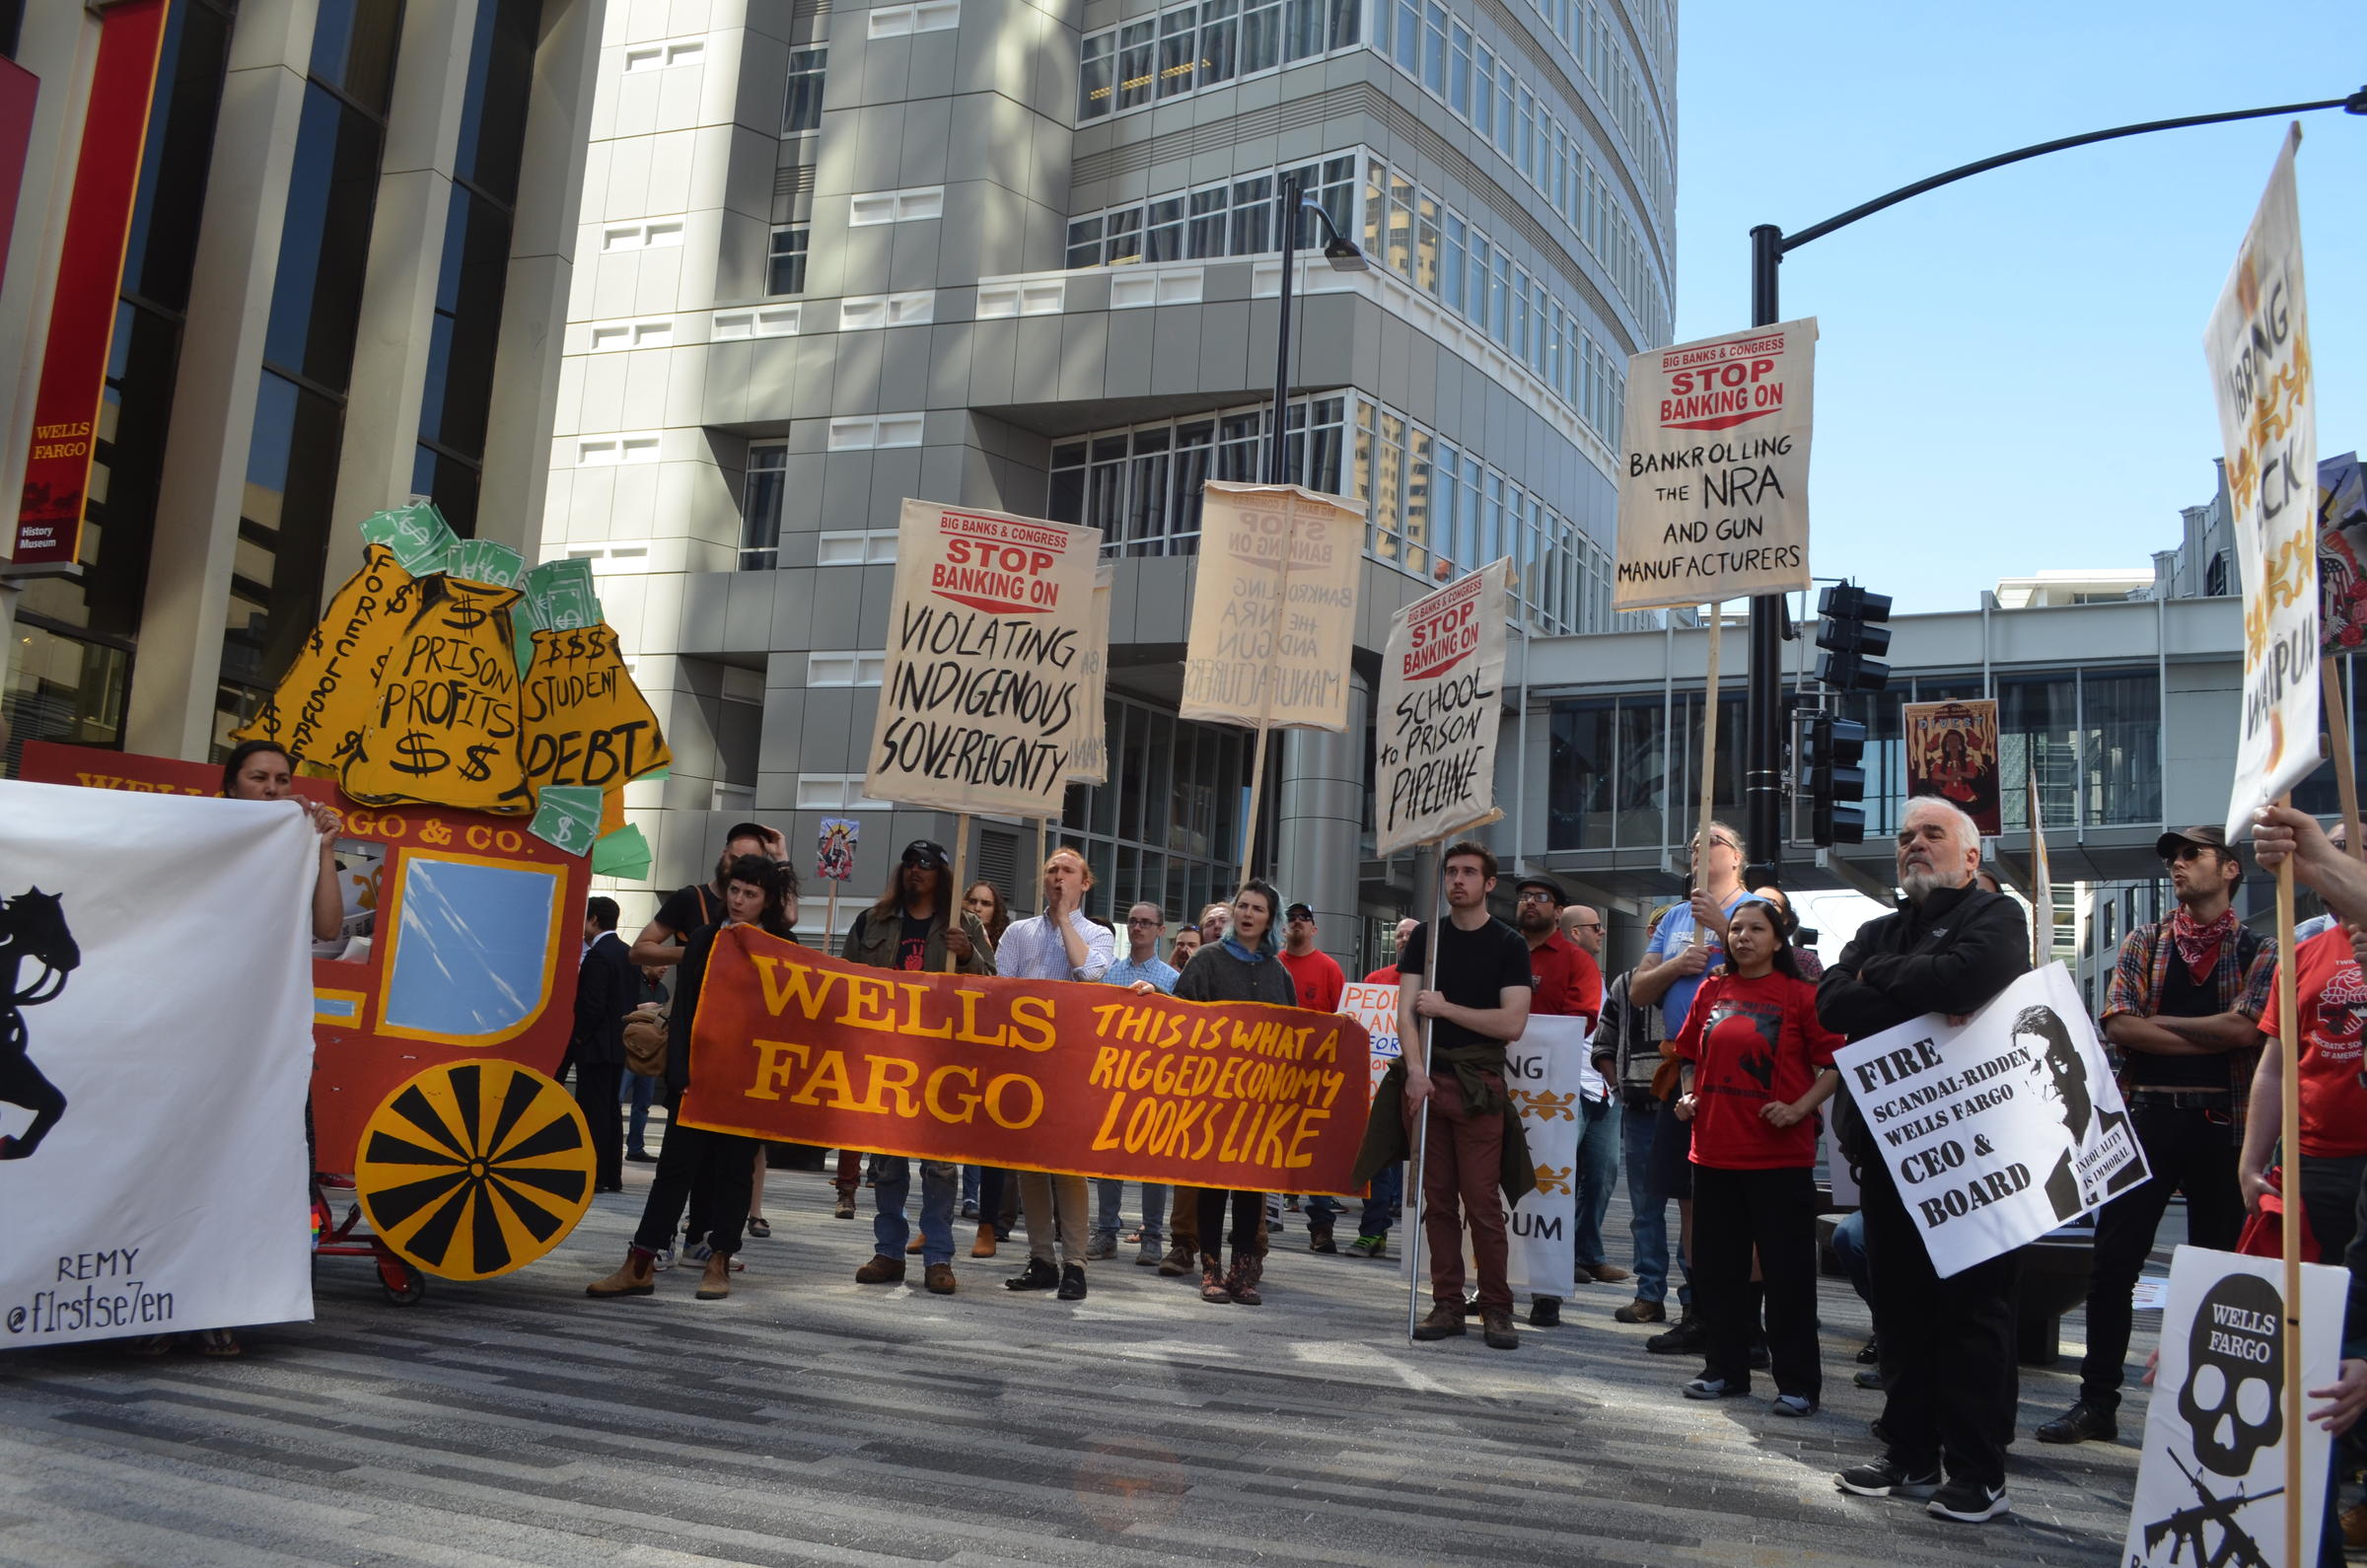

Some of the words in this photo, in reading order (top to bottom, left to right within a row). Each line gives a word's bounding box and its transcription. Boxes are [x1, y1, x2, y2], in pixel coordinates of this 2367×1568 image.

[1662, 353, 1681, 368] BIG
[1683, 349, 1717, 365] BANKS
[1720, 346, 1727, 358] &
[1730, 338, 1785, 358] CONGRESS
[1671, 359, 1775, 396] STOP
[1660, 387, 1749, 422] BANKING
[1755, 383, 1784, 407] ON
[33, 442, 87, 460] FARGO
[36, 422, 91, 439] WELLS
[1629, 434, 1793, 477] BANKROLLING
[1655, 485, 1689, 502] THE
[1704, 464, 1785, 509] NRA
[20, 539, 56, 549] Museum
[22, 527, 53, 537] History
[940, 516, 960, 530] BIG
[962, 520, 998, 536] BANKS
[1001, 526, 1009, 538] &
[1011, 527, 1068, 549] CONGRESS
[1664, 521, 1708, 544] AND
[1716, 515, 1763, 541] GUN
[946, 538, 1054, 577] STOP
[1617, 544, 1801, 583] MANUFACTURERS
[931, 563, 1024, 601] BANKING
[1030, 580, 1059, 606] ON
[1420, 599, 1442, 619] BANKS
[1448, 579, 1483, 606] CONGRESS
[900, 601, 1078, 671] VIOLATING
[1411, 601, 1474, 649] STOP
[402, 634, 514, 696] PRISON
[1402, 630, 1458, 676] BANKING
[1461, 621, 1479, 652] ON
[380, 678, 516, 740] PROFITS
[525, 664, 621, 723] STUDENT
[890, 660, 1077, 737] INDIGENOUS
[1397, 667, 1494, 736] SCHOOL
[1405, 706, 1483, 764] PRISON
[1917, 716, 1984, 730] DIVEST
[527, 719, 649, 789] DEBT
[876, 716, 1068, 796] SOVEREIGNTY
[1388, 745, 1484, 831] PIPELINE
[418, 818, 453, 846] &
[466, 824, 536, 855] CO.
[751, 954, 1057, 1052] WELLS
[1091, 1003, 1187, 1049] THIS
[1187, 1016, 1230, 1050] IS
[1230, 1020, 1316, 1061] WHAT
[1314, 1028, 1339, 1063] A
[743, 1038, 1045, 1130] FARGO
[1089, 1045, 1218, 1098] RIGGED
[1212, 1056, 1345, 1109] ECONOMY
[1853, 1036, 1944, 1094] FIRE
[1872, 1045, 2032, 1124] SCANDAL-RIDDEN
[1091, 1091, 1224, 1162] LOOKS
[1217, 1101, 1331, 1169] LIKE
[1883, 1110, 1950, 1148] WELLS
[1953, 1083, 2015, 1122] FARGO
[1900, 1139, 1966, 1184] CEO
[1973, 1133, 1995, 1157] &
[2075, 1129, 2122, 1174] INEQUALITY
[2083, 1176, 2094, 1189] IS
[2093, 1147, 2130, 1181] IMMORAL
[1917, 1162, 2032, 1229] BOARD
[57, 1247, 140, 1282] REMY
[2212, 1303, 2277, 1336] WELLS
[2207, 1330, 2271, 1364] FARGO
